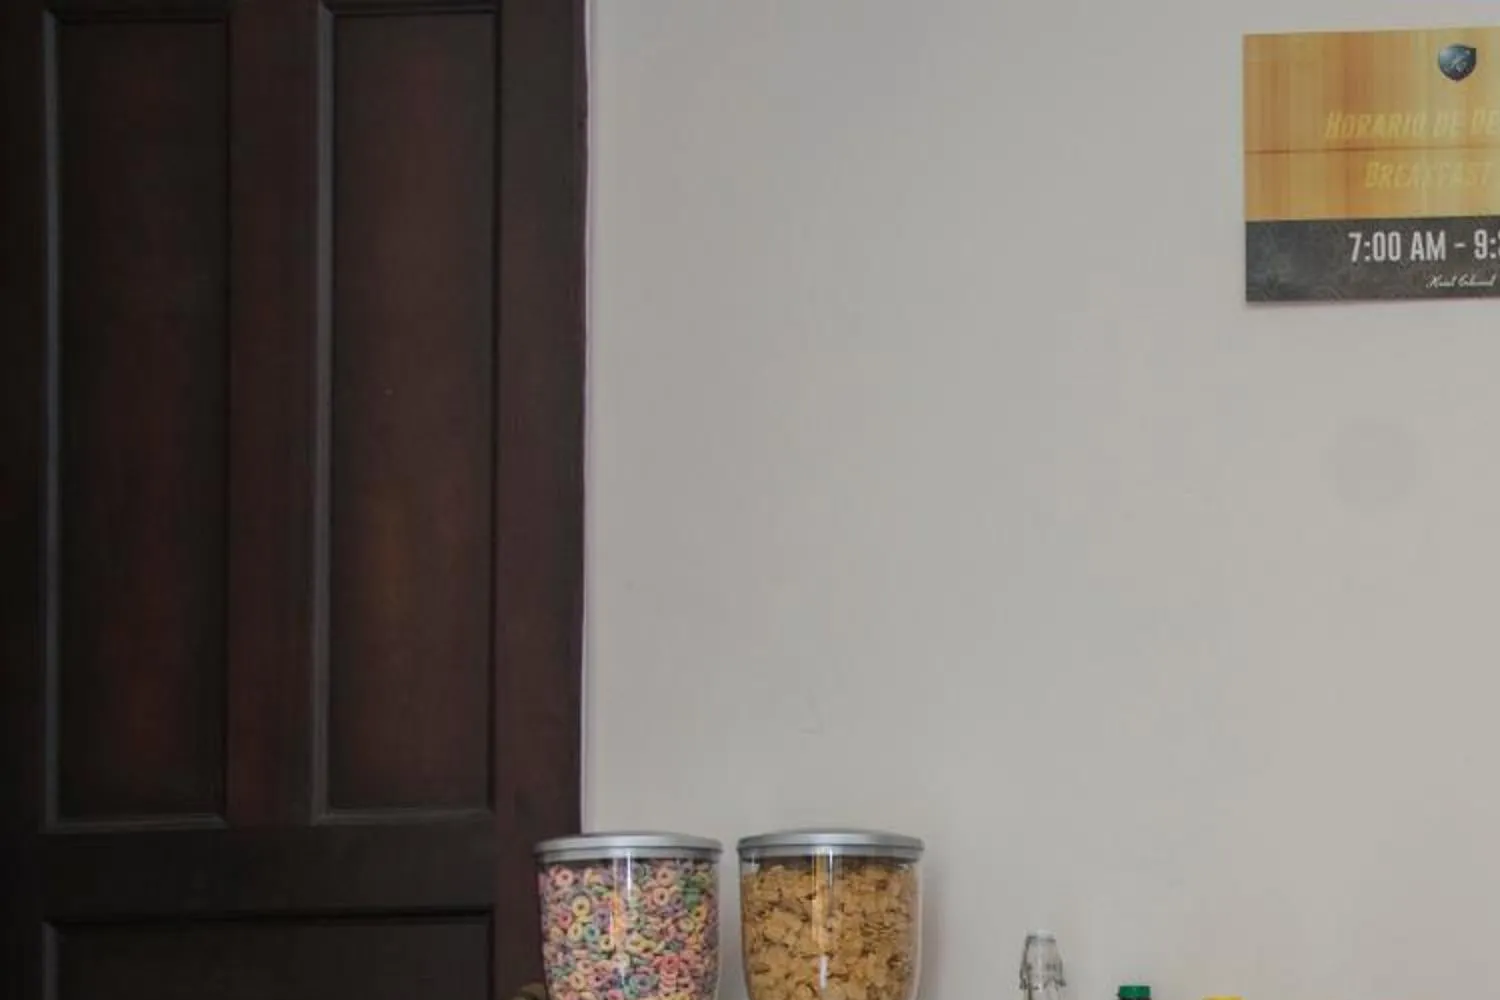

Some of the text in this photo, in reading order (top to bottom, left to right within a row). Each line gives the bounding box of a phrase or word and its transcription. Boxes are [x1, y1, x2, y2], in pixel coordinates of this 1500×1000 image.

[1324, 110, 1427, 139] HORARIO
[1433, 110, 1464, 138] DE
[1348, 231, 1402, 262] 7:00
[1410, 230, 1446, 261] AM
